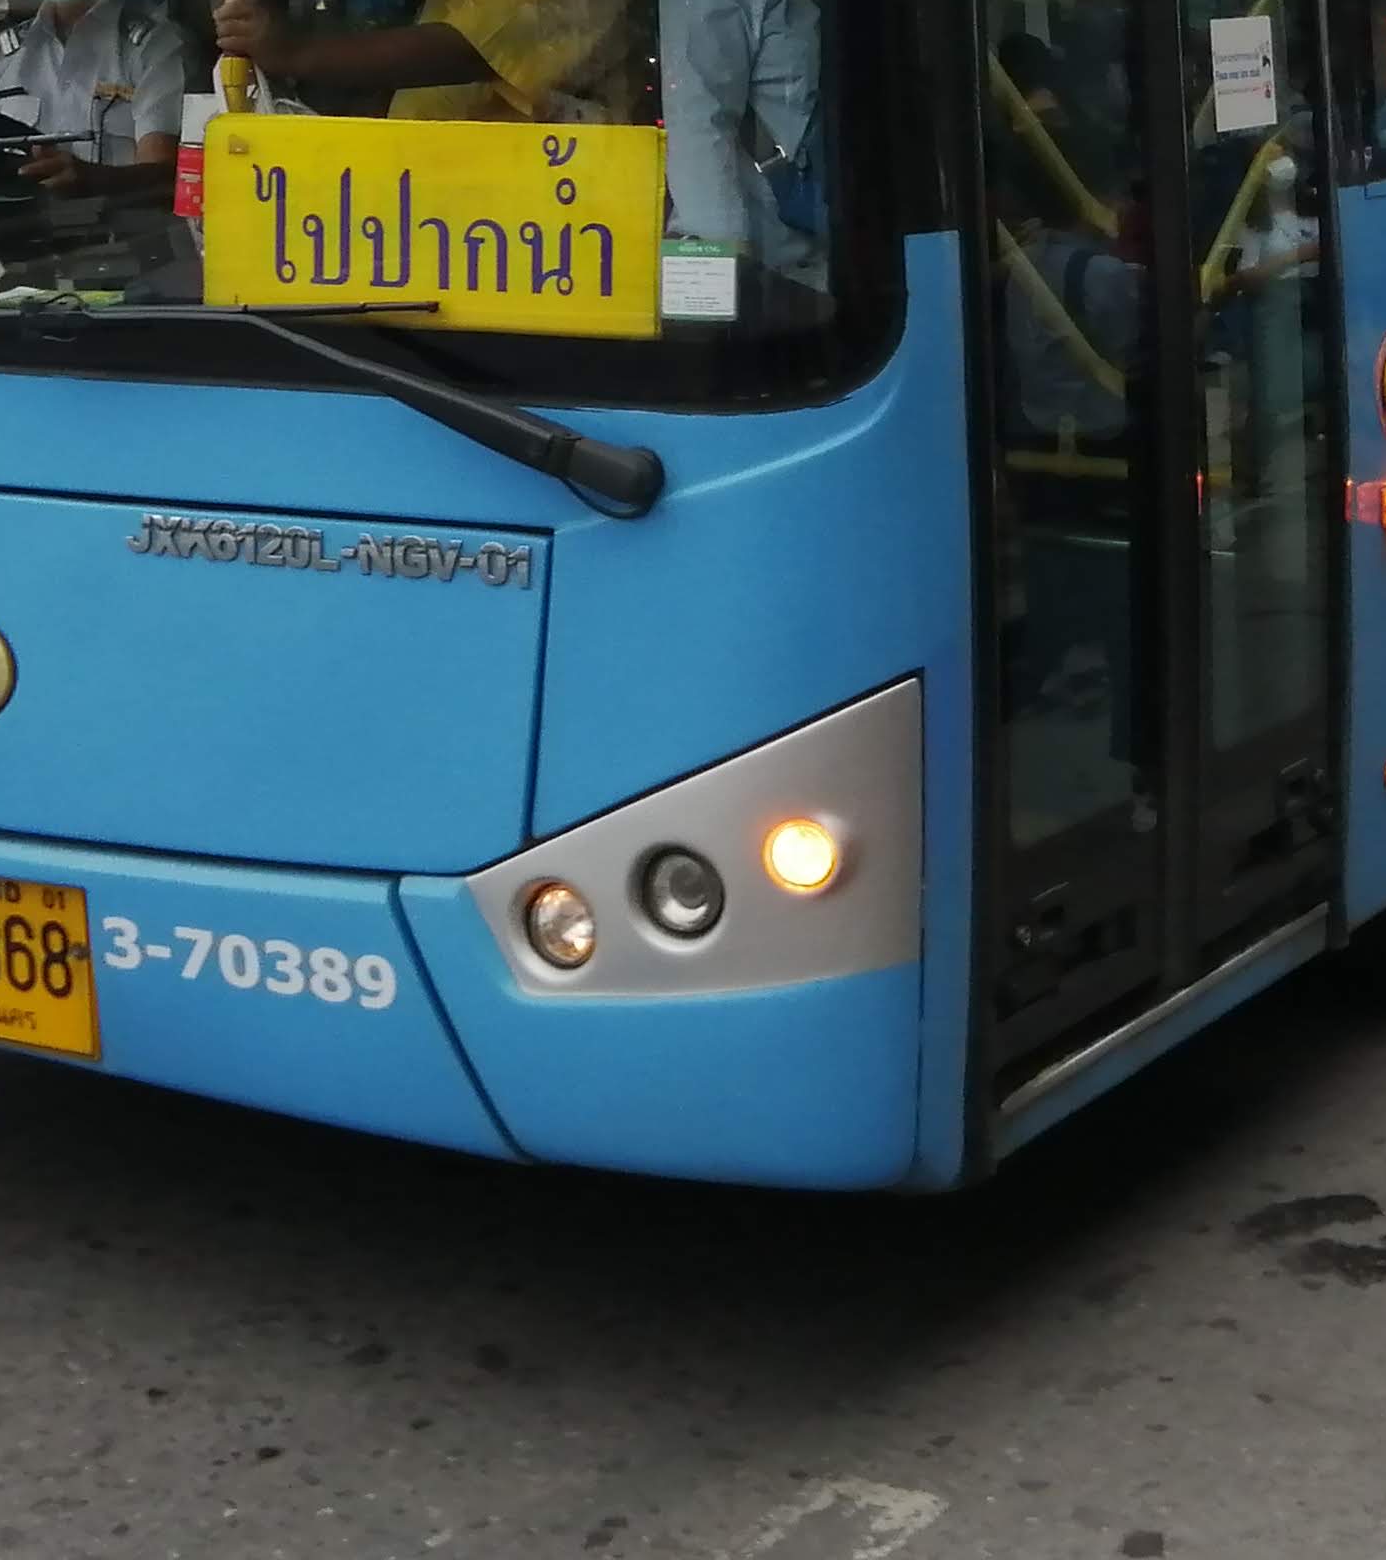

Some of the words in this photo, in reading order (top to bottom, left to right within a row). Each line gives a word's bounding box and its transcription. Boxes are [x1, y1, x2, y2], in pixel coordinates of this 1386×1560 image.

[251, 133, 614, 298] ไปปากน้ำ
[126, 514, 532, 590] JXK6120L-NGV-01
[102, 914, 398, 1011] 3-70389
